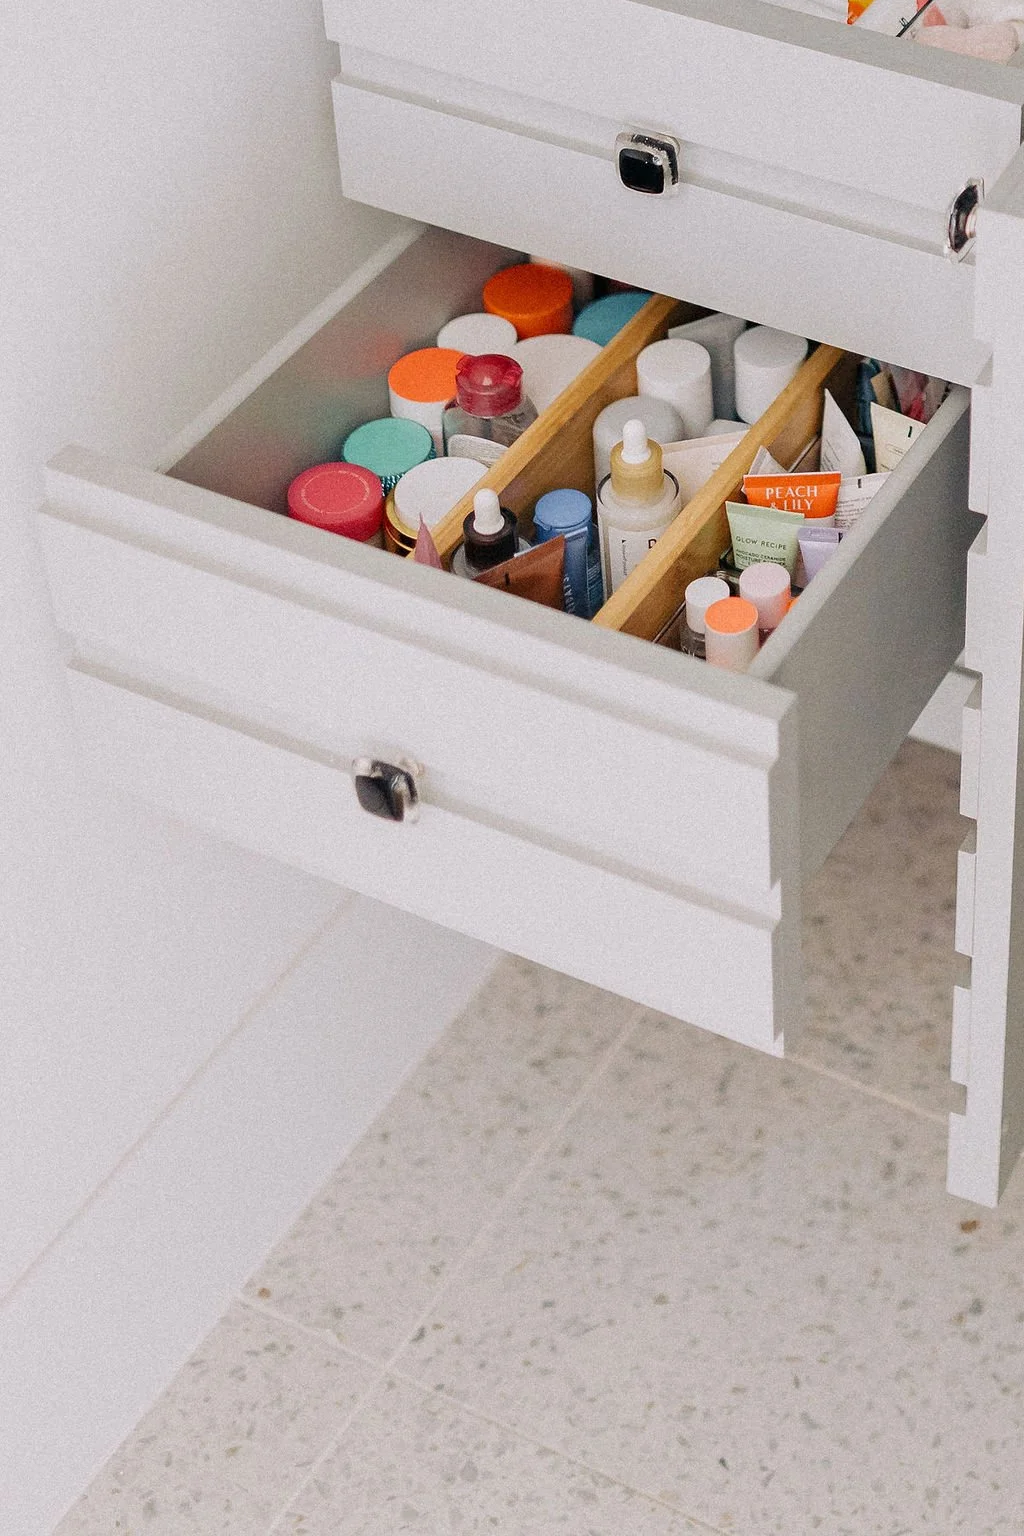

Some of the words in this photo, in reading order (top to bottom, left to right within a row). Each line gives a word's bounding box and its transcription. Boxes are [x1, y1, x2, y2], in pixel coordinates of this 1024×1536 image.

[765, 485, 818, 500] PEACH
[770, 502, 778, 511] &
[783, 499, 814, 511] LILY
[735, 535, 758, 545] GLOW
[760, 540, 787, 551] RECIPE
